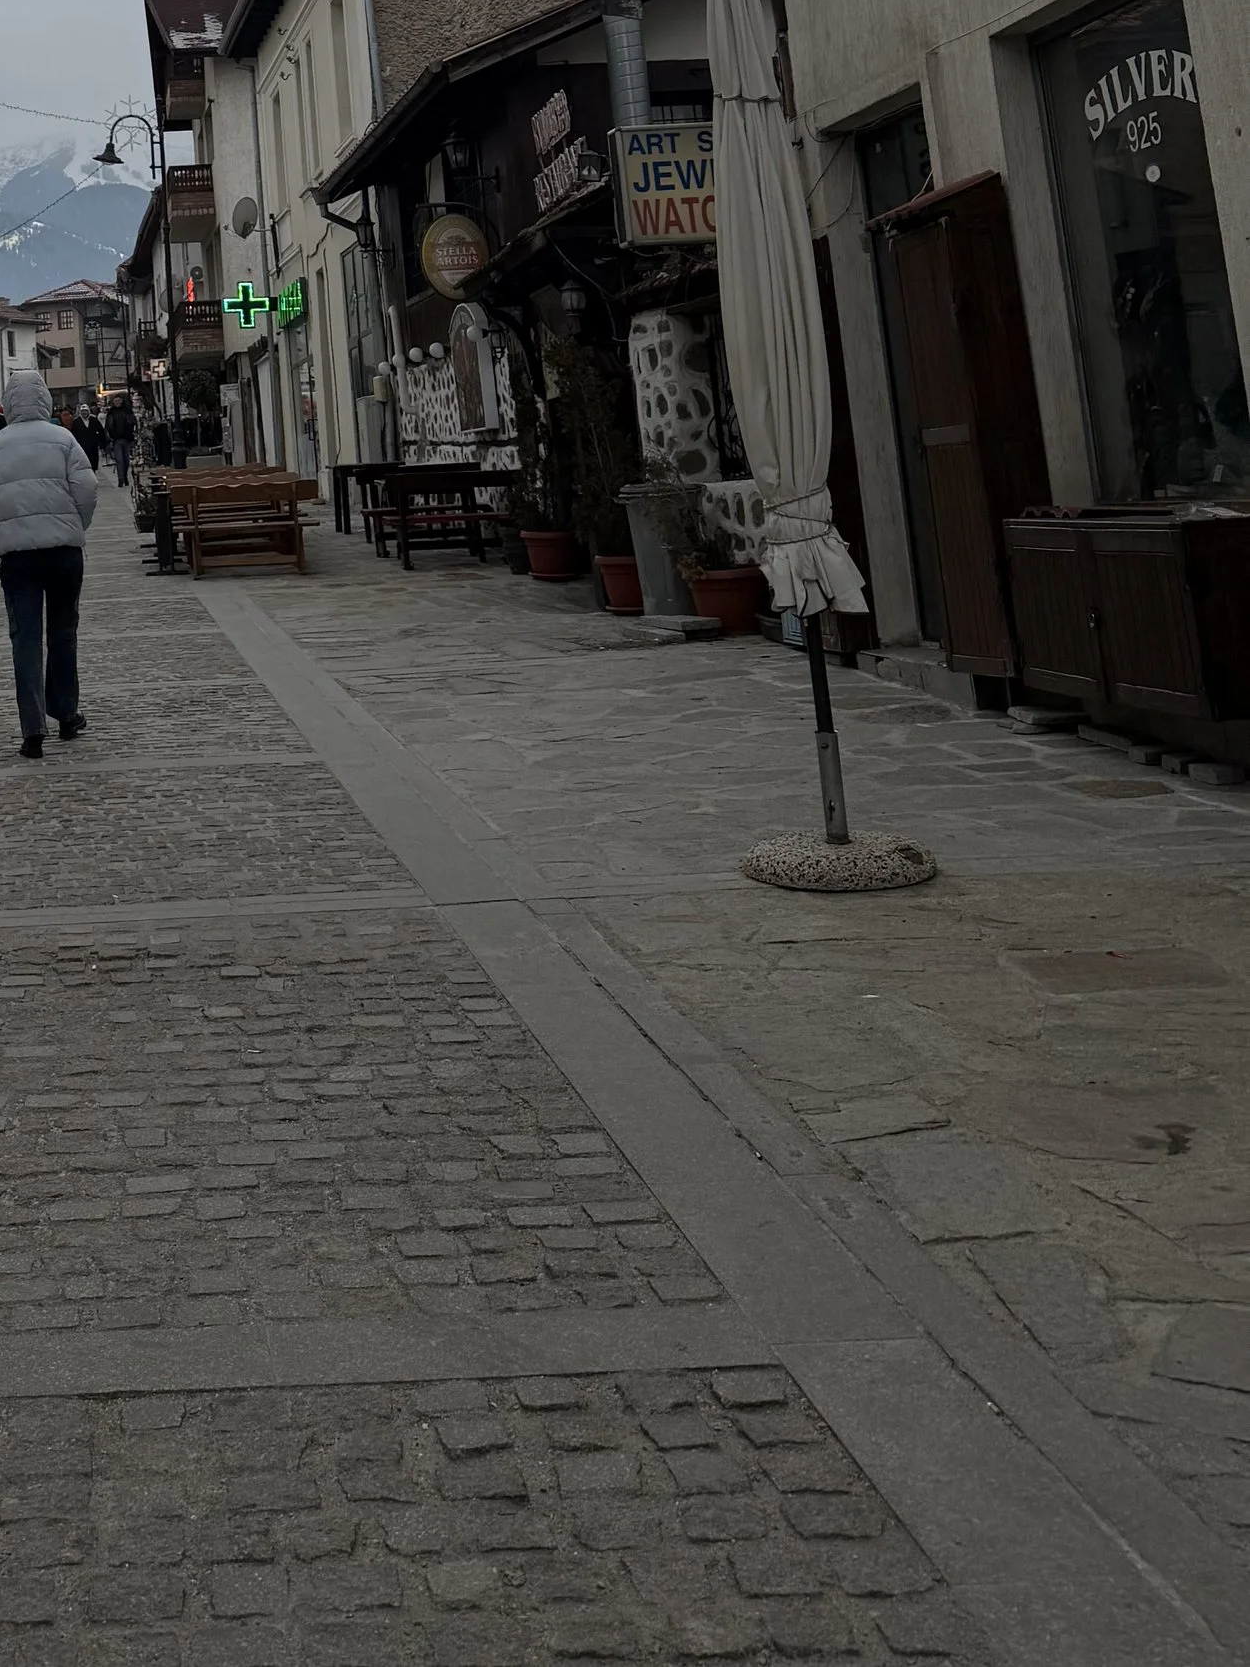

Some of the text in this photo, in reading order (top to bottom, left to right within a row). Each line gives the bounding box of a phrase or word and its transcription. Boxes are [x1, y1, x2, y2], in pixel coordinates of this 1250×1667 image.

[1084, 48, 1199, 142] SILVER
[628, 132, 681, 156] ART
[1126, 110, 1163, 154] 925
[632, 158, 715, 194] JEW
[435, 245, 477, 257] STELLA
[436, 255, 479, 266] ARTOIS
